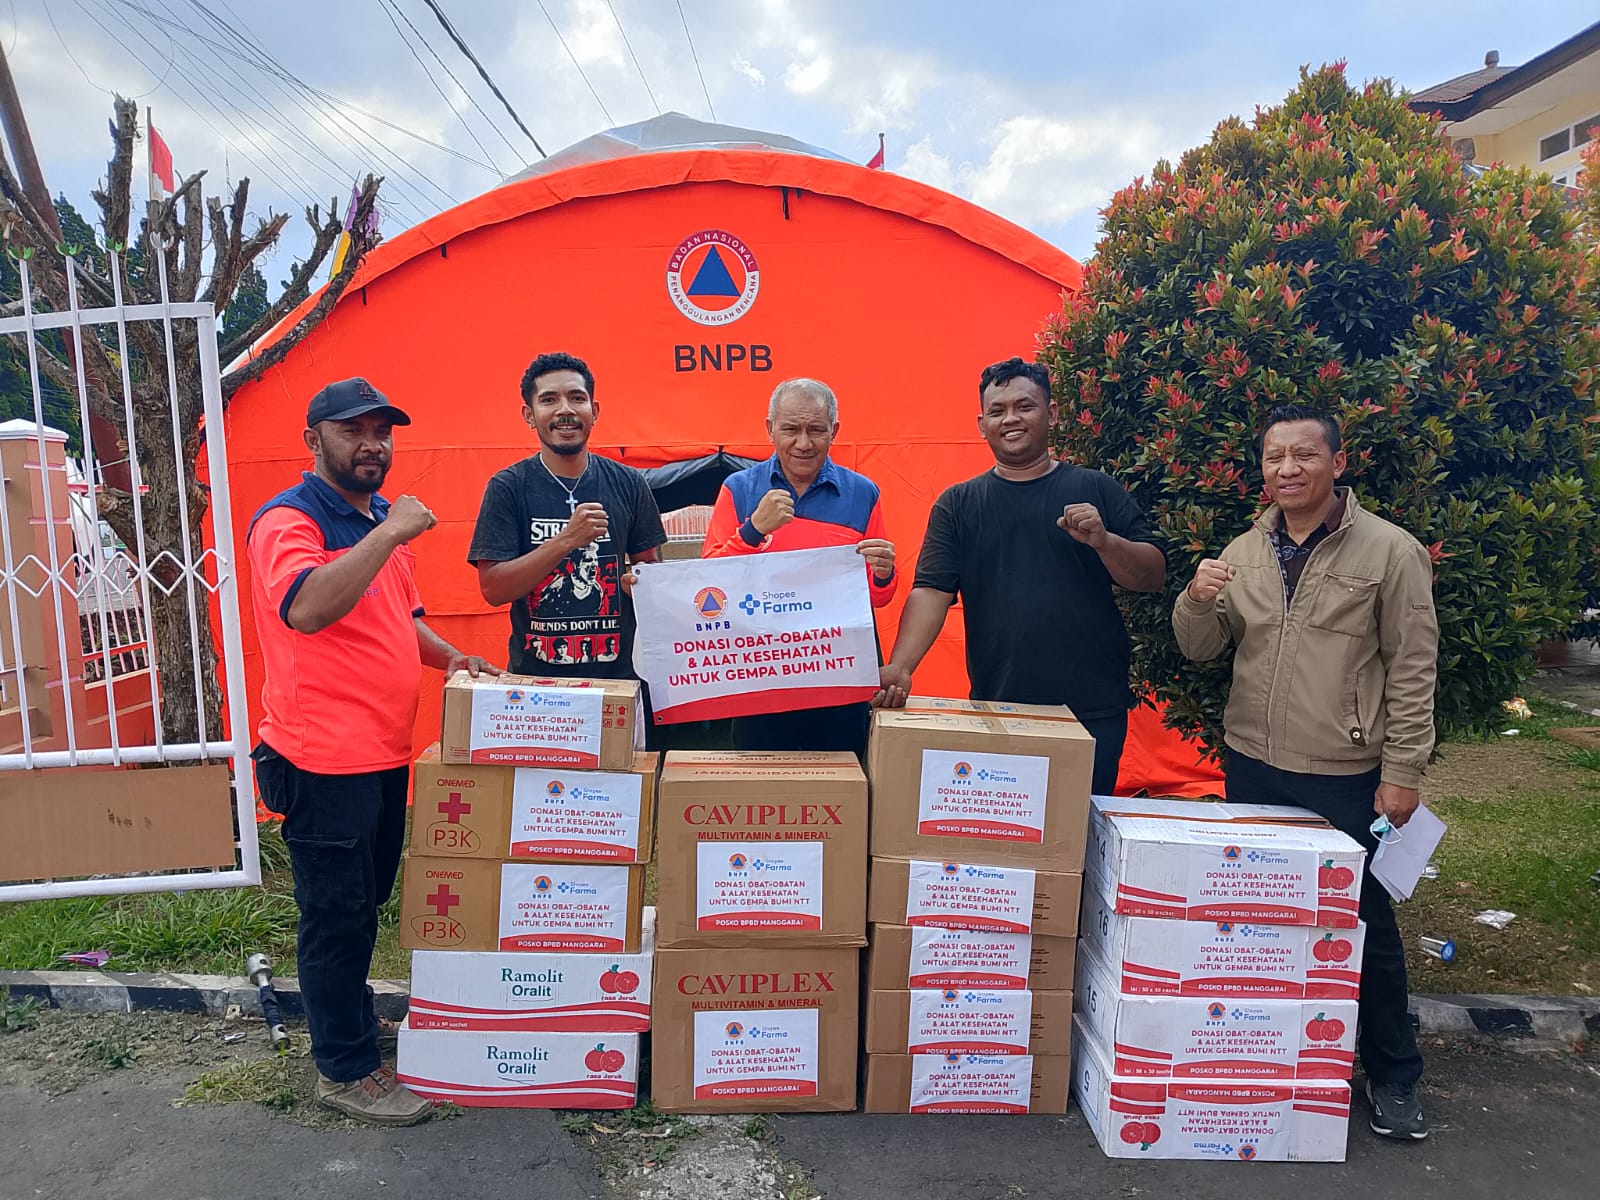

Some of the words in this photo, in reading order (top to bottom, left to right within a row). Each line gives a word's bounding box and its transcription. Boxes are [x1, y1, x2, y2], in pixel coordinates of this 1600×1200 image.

[671, 235, 701, 269] BADAN
[704, 233, 754, 267] NASIONAL
[670, 275, 735, 322] PENANGGULANGAN
[735, 274, 757, 314] BENCANA
[675, 344, 773, 372] BNPB
[763, 591, 796, 601] Shopee
[763, 600, 813, 614] Farma
[530, 621, 567, 632] FRIENDS
[696, 621, 730, 631] BNPB
[674, 639, 730, 654] DONASI
[735, 626, 842, 648] OBAT-OBATAN
[688, 658, 697, 668] &
[702, 654, 738, 667] ALAT
[743, 644, 832, 664] KESEHATAN
[669, 672, 720, 686] UNTUK
[725, 665, 777, 680] GEMPA
[783, 661, 820, 675] BUMI
[826, 656, 855, 670] NTT
[543, 699, 571, 707] Farma
[490, 714, 522, 722] DONASI
[525, 715, 584, 725] OBAT-OBATAN
[505, 723, 526, 731] ALAT
[528, 724, 577, 733] KESEHATAN
[516, 733, 546, 741] GEMPA
[572, 734, 588, 742] NTT
[437, 778, 475, 788] ONEMED
[990, 774, 1016, 783] Farma
[938, 788, 969, 796] DONASI
[971, 790, 1029, 800] OBAT-OBATAN
[952, 797, 972, 805] ALAT
[974, 798, 1022, 808] KESEHATAN
[683, 804, 842, 825] CAVIPLEX
[931, 805, 961, 813] UNTUK
[963, 806, 991, 815] GEMPA
[993, 808, 1014, 816] BUMI
[1017, 809, 1032, 817] NTT
[697, 831, 772, 840] MULTIVITAMIN
[775, 831, 780, 840] &
[785, 831, 831, 840] MINERAL
[937, 825, 960, 833] POSKO
[981, 828, 1024, 837] MANGGARAI
[434, 829, 472, 848] P3K
[1096, 835, 1105, 861] 14
[1260, 856, 1289, 864] Farma
[426, 870, 464, 879] ONEMED
[1206, 872, 1239, 880] DONASI
[1241, 873, 1302, 881] OBAT-OBATAN
[570, 887, 597, 895] Farma
[1232, 890, 1262, 898] GEMPA
[552, 903, 610, 911] OBAT-OBATAN
[1099, 909, 1109, 936] 16
[423, 922, 460, 938] P3K
[501, 968, 564, 983] Ramolit
[678, 972, 834, 995] CAVIPLEX
[512, 985, 551, 997] Oralit
[692, 1000, 765, 1009] MULTIVITAMIN
[768, 999, 774, 1008] &
[778, 998, 824, 1008] MINERAL
[1087, 985, 1097, 1012] 15
[1225, 1030, 1283, 1038] OBAT-OBATAN
[487, 1046, 549, 1061] Ramolit
[497, 1063, 536, 1075] Oralit
